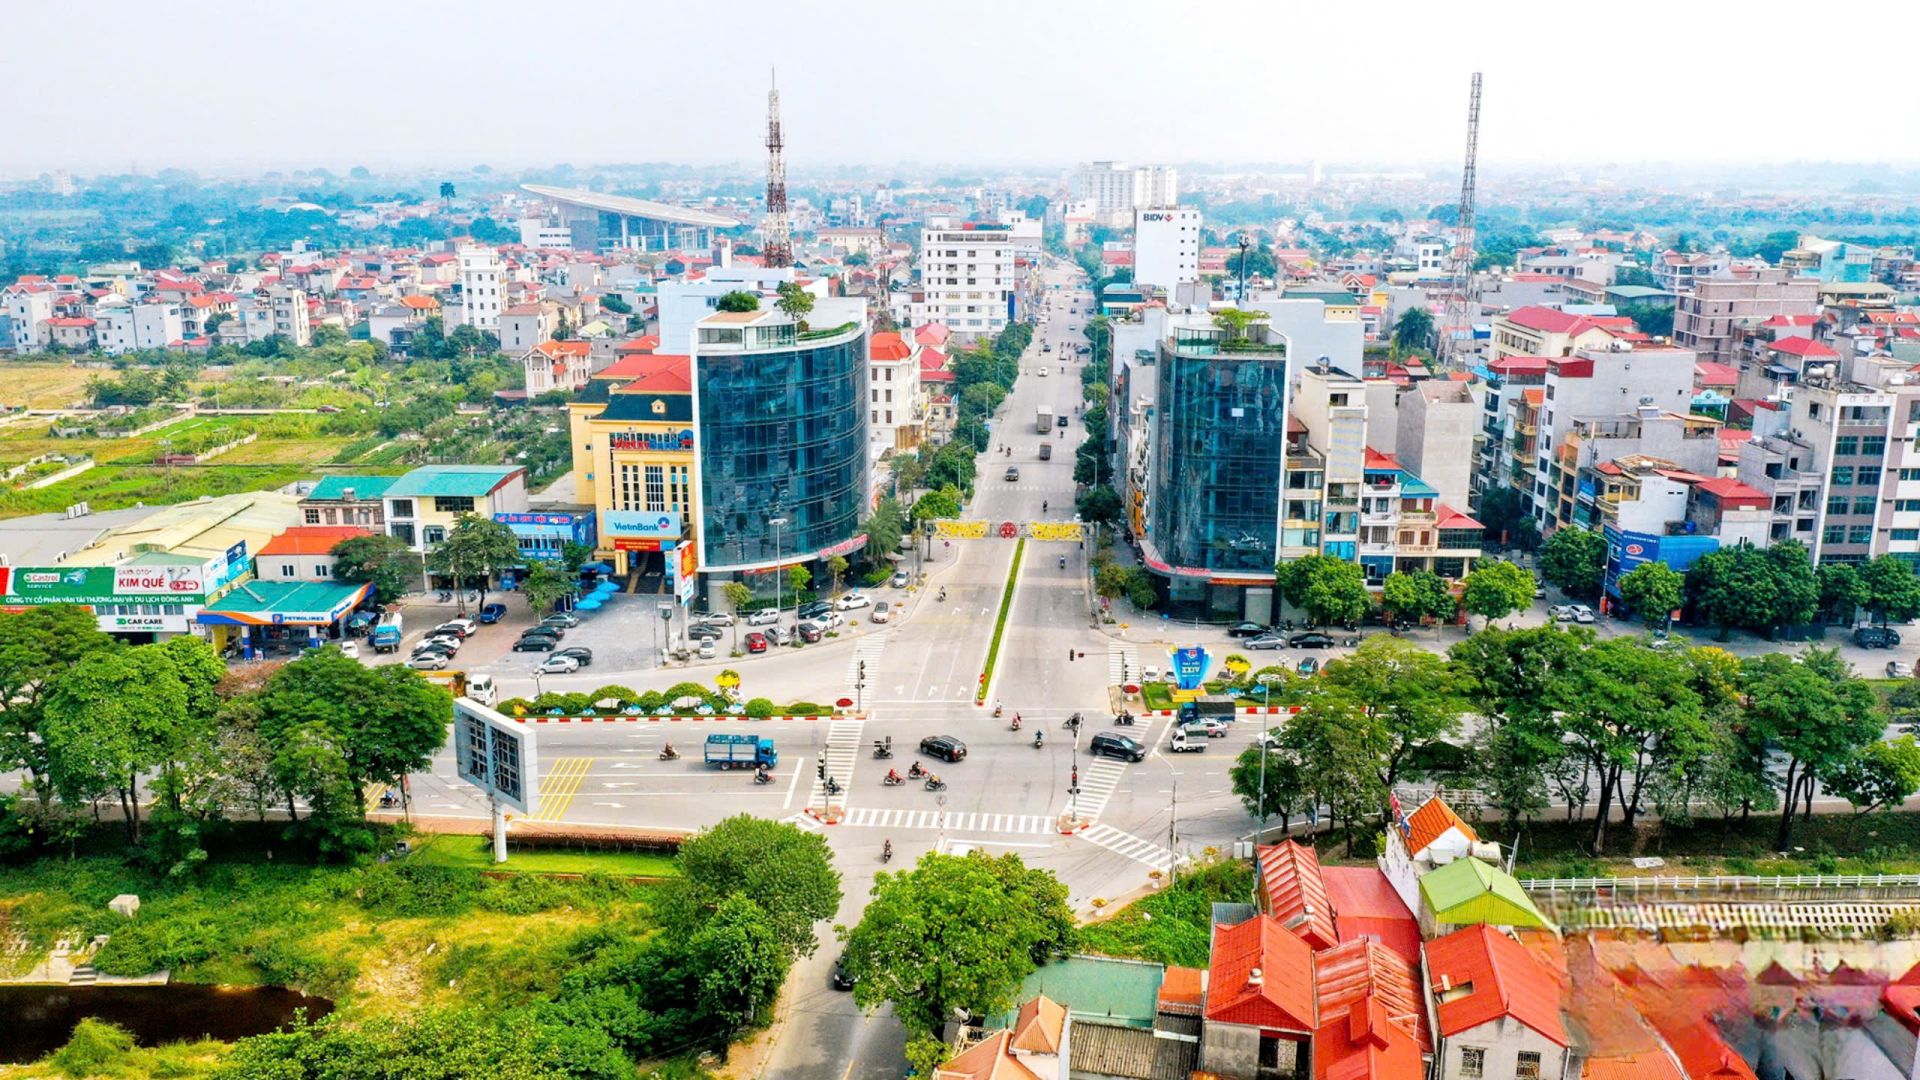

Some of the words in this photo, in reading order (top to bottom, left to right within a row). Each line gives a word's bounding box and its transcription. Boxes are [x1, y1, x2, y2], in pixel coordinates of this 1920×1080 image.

[1143, 213, 1164, 221] BIDV
[614, 522, 660, 531] VietinBank
[32, 573, 58, 581] Castrol
[119, 578, 139, 587] KIM
